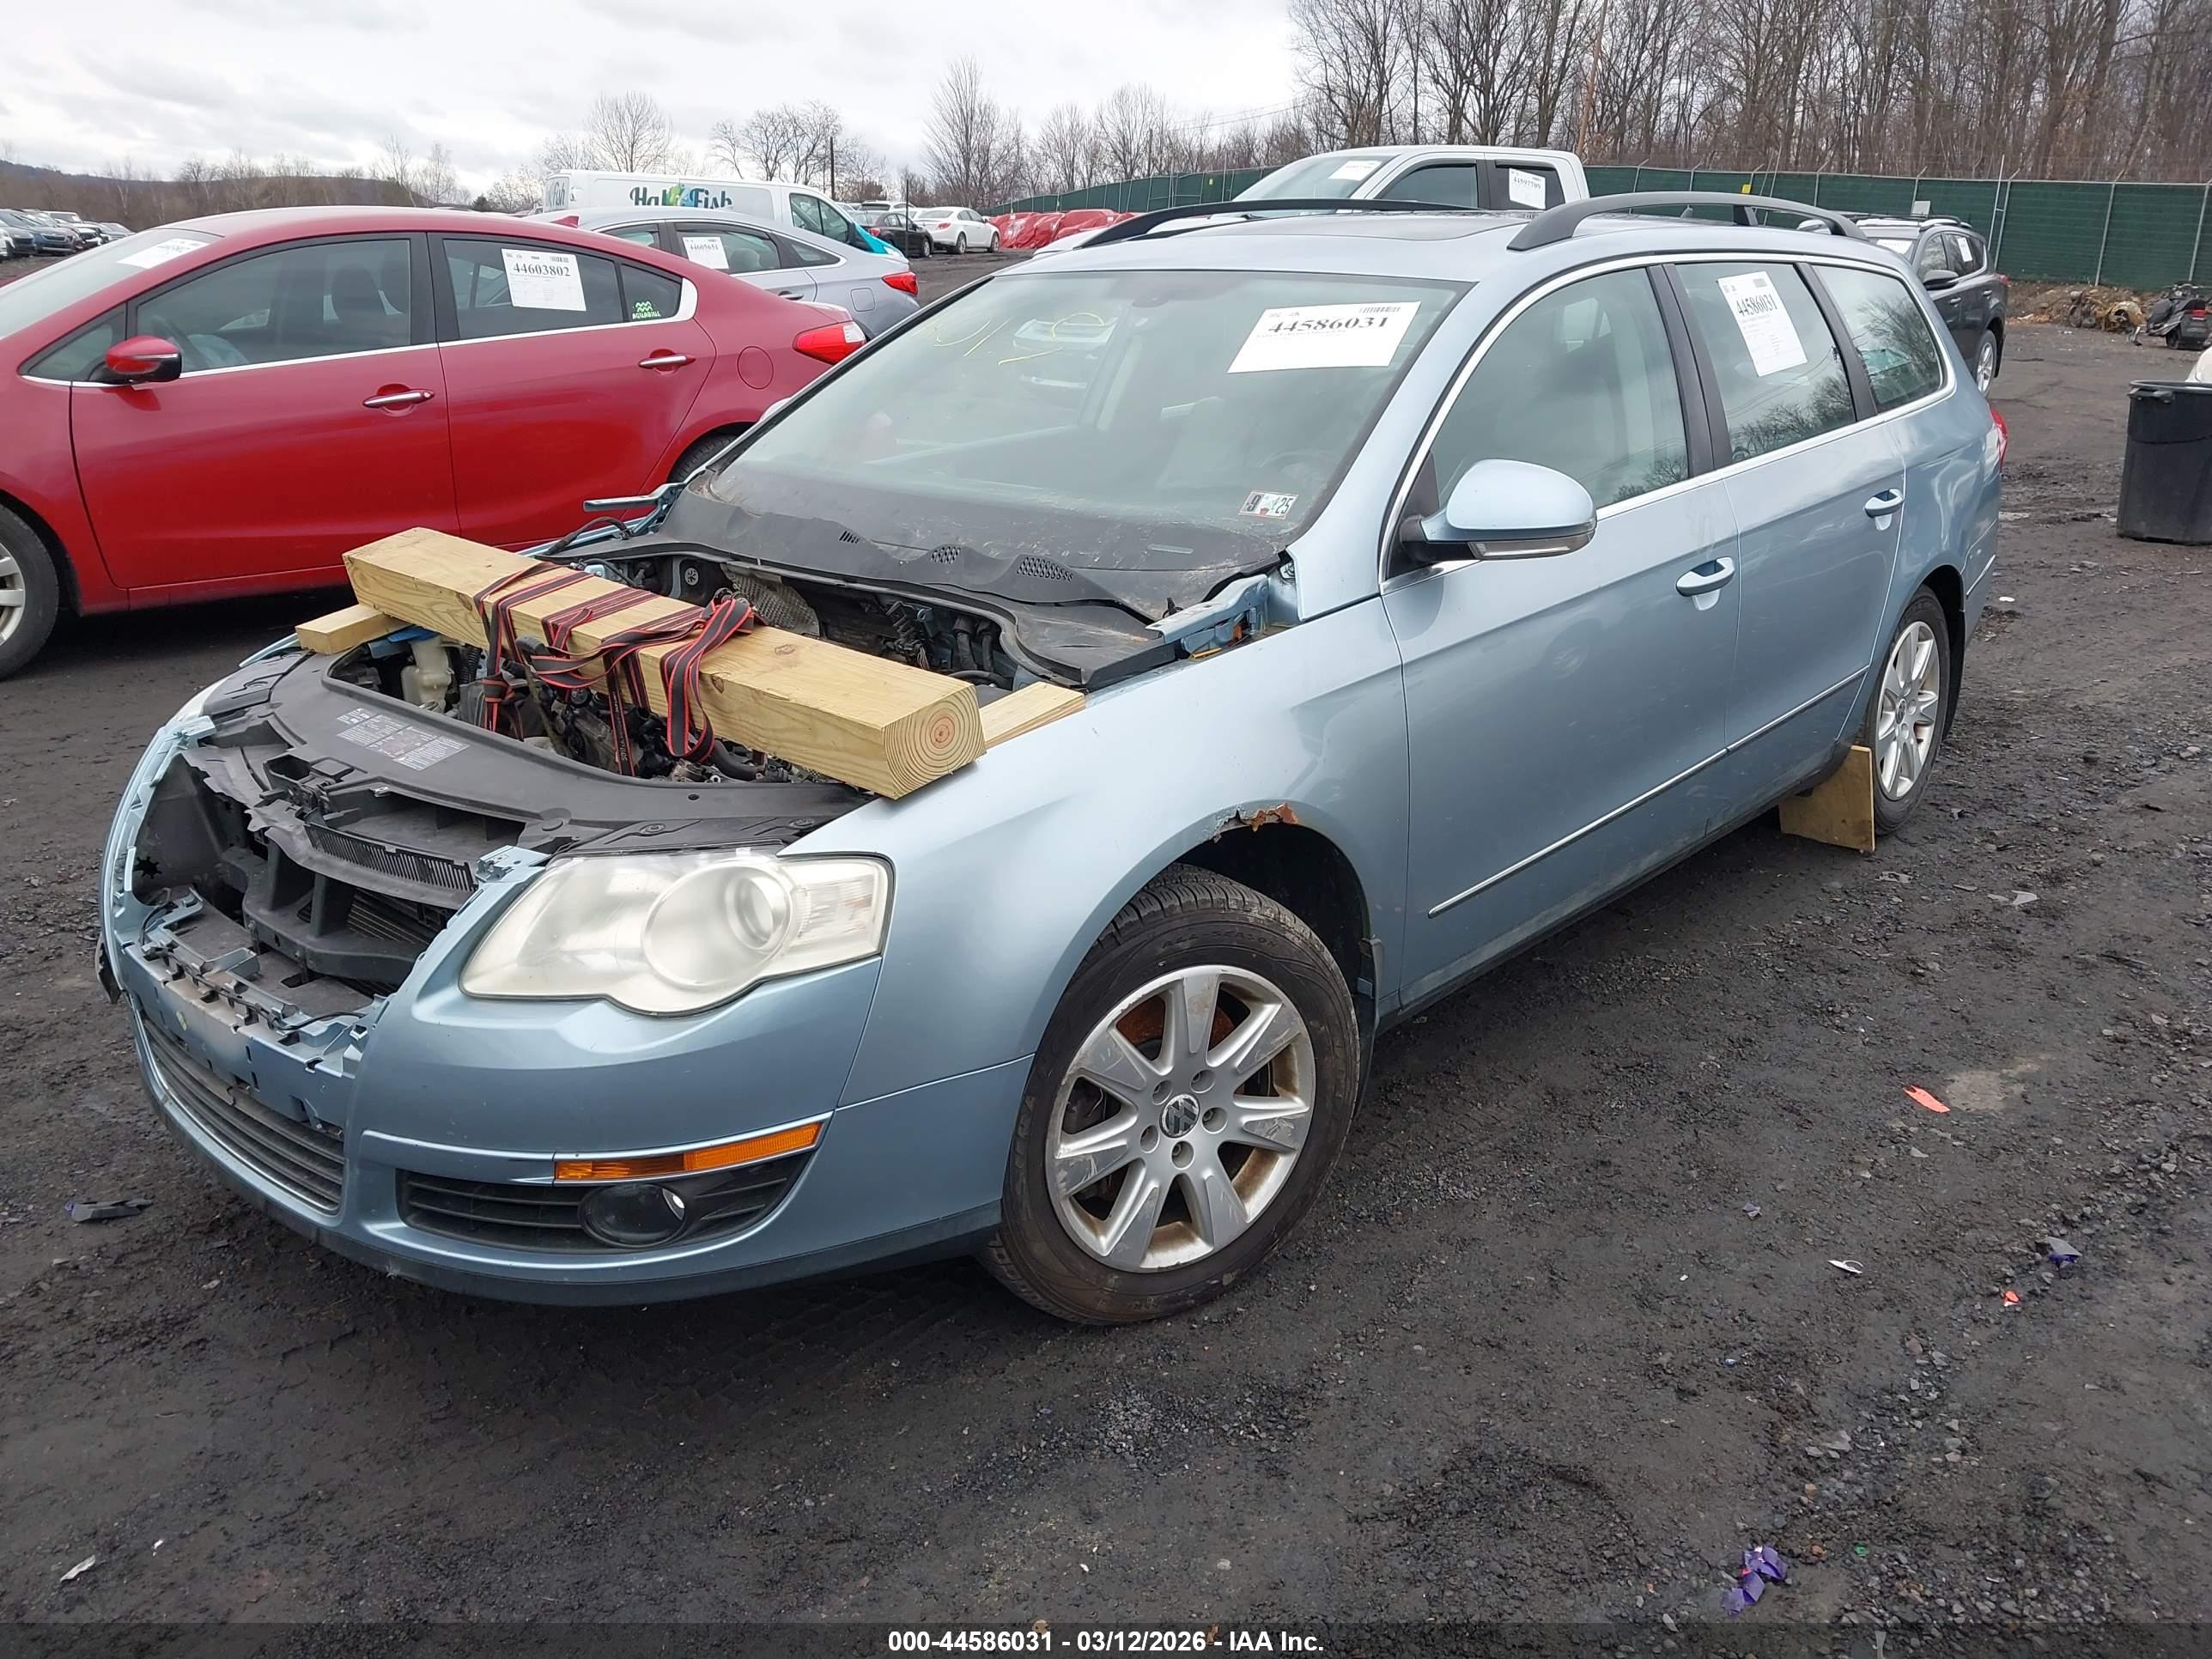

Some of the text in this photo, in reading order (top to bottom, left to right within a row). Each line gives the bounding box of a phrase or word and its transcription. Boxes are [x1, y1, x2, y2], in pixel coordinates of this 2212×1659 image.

[513, 263, 571, 277] 44603802
[1735, 293, 1778, 317] 44586031
[1268, 316, 1389, 333] 44586031
[1274, 497, 1294, 514] 25
[1161, 930, 1279, 949] ALL-SEASON
